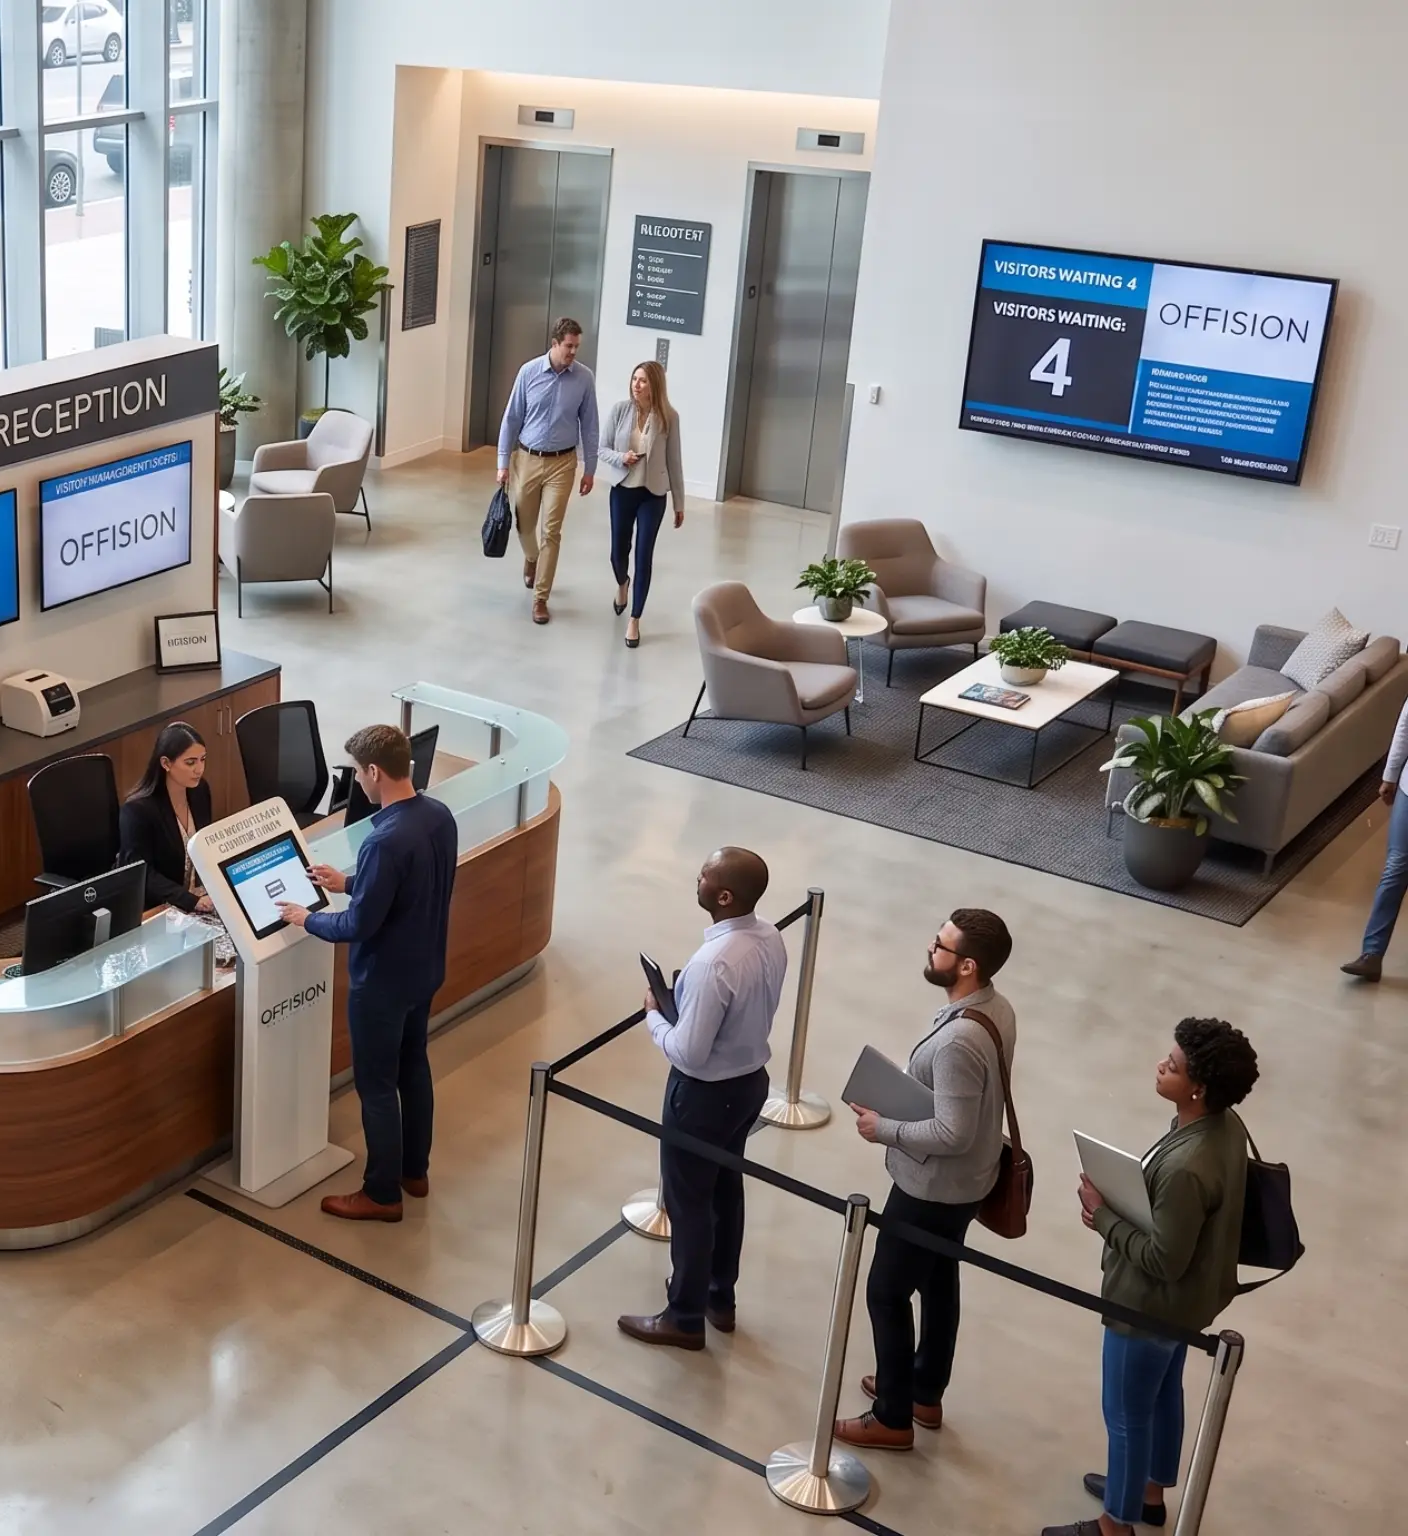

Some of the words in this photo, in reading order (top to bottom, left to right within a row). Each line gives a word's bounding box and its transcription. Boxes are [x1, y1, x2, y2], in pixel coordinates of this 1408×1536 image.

[994, 260, 1056, 280] VISITORS
[1059, 269, 1123, 289] WAITING
[1126, 277, 1138, 290] 4
[993, 301, 1056, 323] VISITORS
[1058, 310, 1127, 332] WAITING:
[1159, 302, 1309, 344] OFFISION
[1030, 337, 1073, 397] 4
[60, 506, 176, 566] OFFISION
[261, 980, 326, 1025] OFFISION
